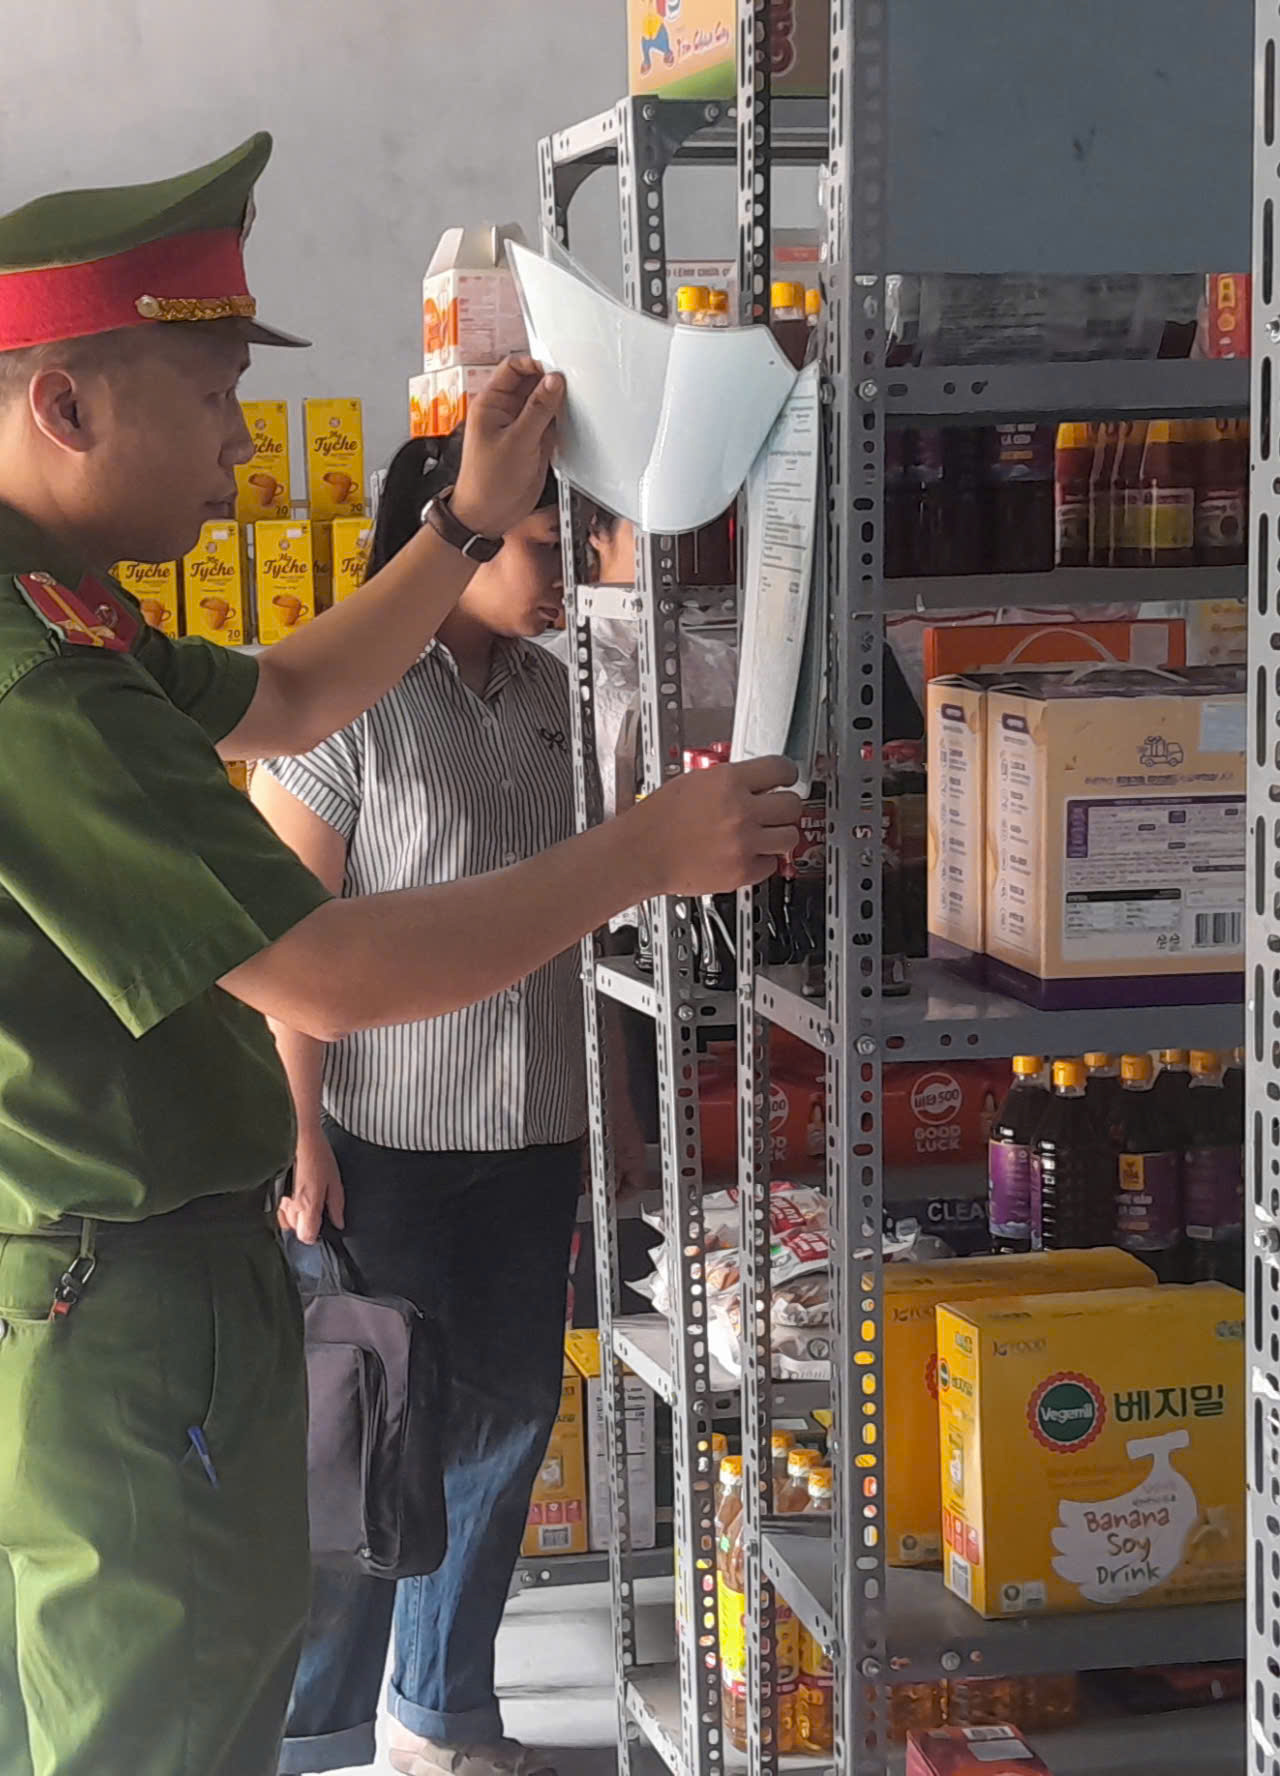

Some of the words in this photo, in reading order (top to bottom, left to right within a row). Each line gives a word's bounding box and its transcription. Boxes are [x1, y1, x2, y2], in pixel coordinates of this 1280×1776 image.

[253, 439, 283, 454] yche
[314, 437, 358, 456] Tyche
[276, 506, 289, 517] 20
[350, 503, 363, 513] 20
[125, 563, 171, 582] Tyche
[191, 562, 235, 580] Tyche
[263, 559, 308, 579] Tyche
[228, 629, 241, 640] 20
[914, 1125, 961, 1139] GOOD
[916, 1139, 961, 1152] LUCK
[927, 1202, 989, 1221] CLEA
[1115, 1383, 1225, 1423] 베지밀
[1041, 1405, 1093, 1424] Vegemil
[1083, 1507, 1170, 1533] Banana
[1107, 1532, 1151, 1563] Soy
[1096, 1561, 1160, 1585] Drink
